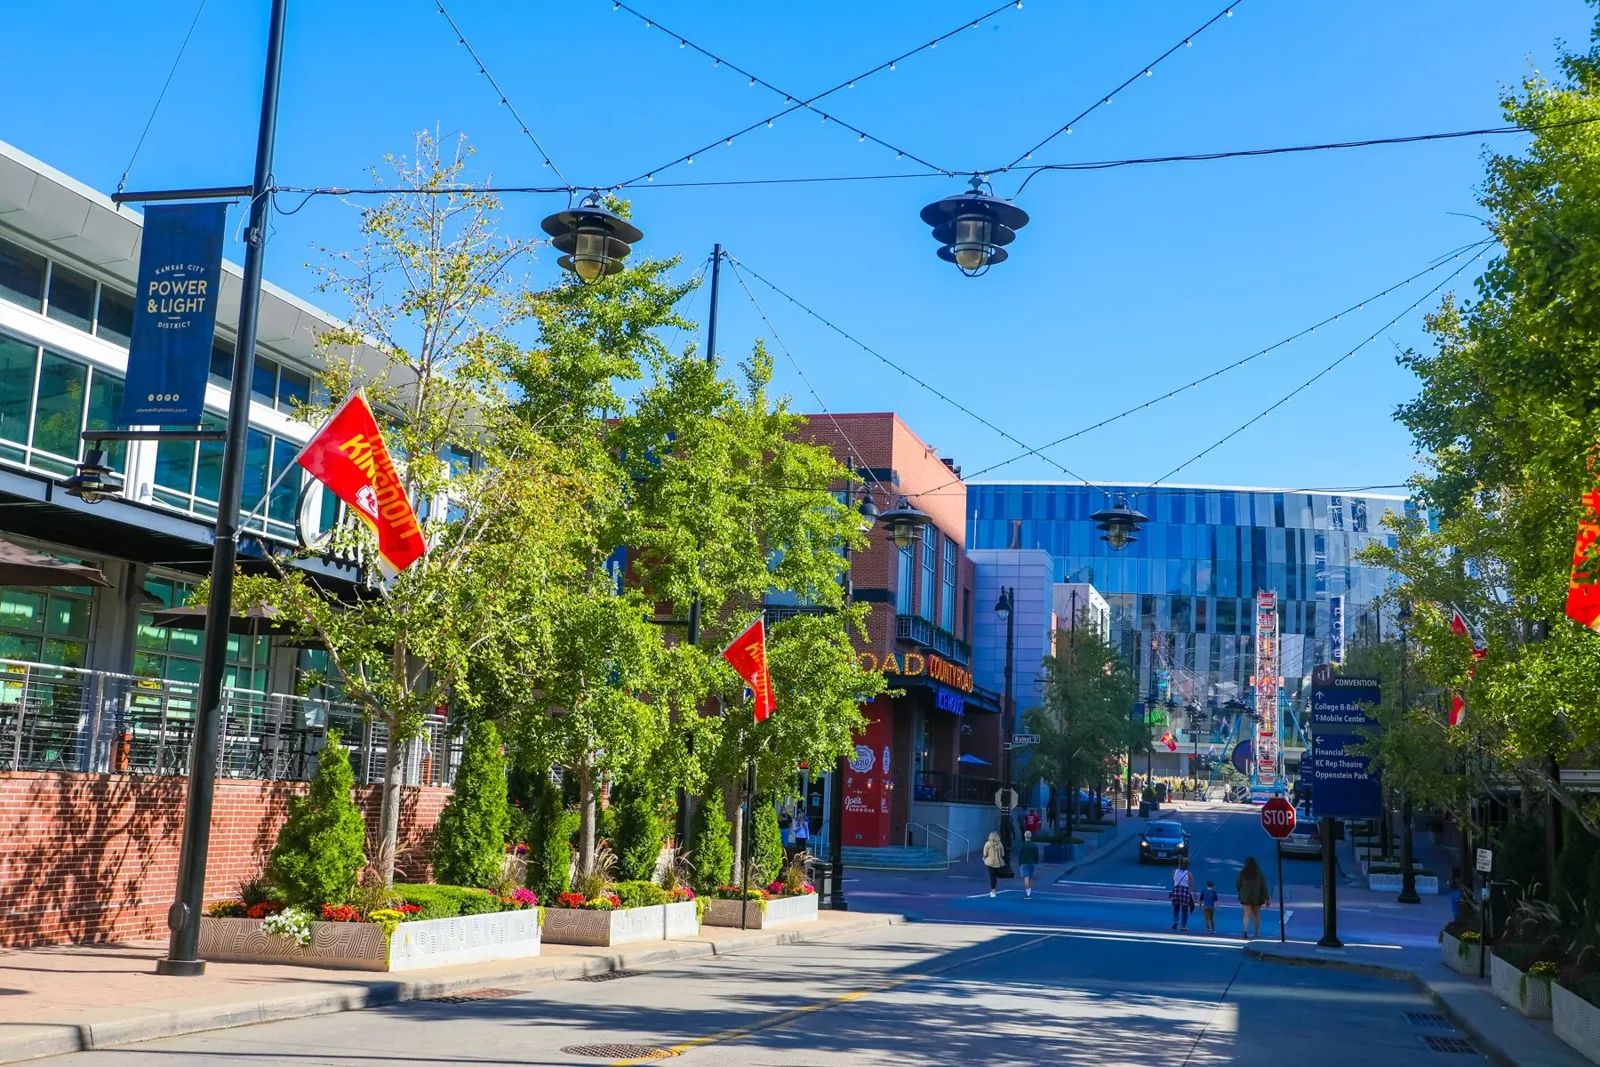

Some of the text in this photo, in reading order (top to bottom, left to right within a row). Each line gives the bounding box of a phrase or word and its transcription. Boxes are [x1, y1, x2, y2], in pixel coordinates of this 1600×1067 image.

[155, 263, 205, 275] KANSAS CITY
[149, 280, 208, 296] POWER
[160, 298, 206, 313] LIGHT
[157, 320, 191, 329] DISTRICT
[1332, 607, 1341, 658] POWE
[858, 651, 925, 676] OAD
[1334, 679, 1377, 687] CONVENTION
[1314, 703, 1359, 712] College B-Ball
[1315, 714, 1343, 722] T-Mobile
[1315, 748, 1344, 757] Financial
[1325, 760, 1338, 769] Rep
[1338, 760, 1363, 768] Theatre
[1315, 770, 1369, 779] Oppenstein Park
[1263, 809, 1294, 825] STOP
